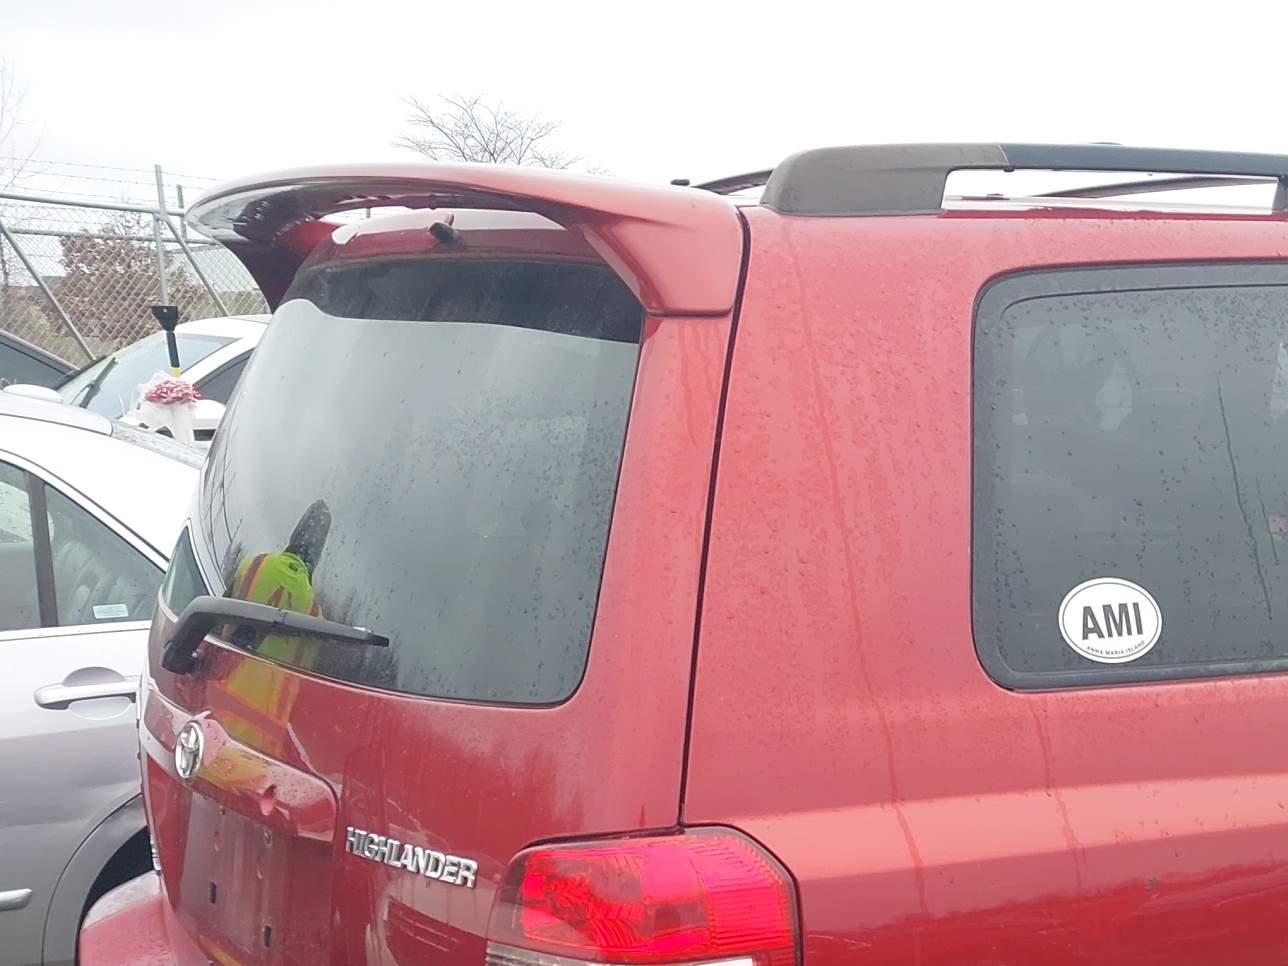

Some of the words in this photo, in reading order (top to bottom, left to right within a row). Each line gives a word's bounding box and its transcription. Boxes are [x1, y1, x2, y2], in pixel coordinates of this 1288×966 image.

[1082, 602, 1144, 640] AMI
[1125, 640, 1145, 653] ISLAND
[345, 826, 478, 888] HIGHLANDER
